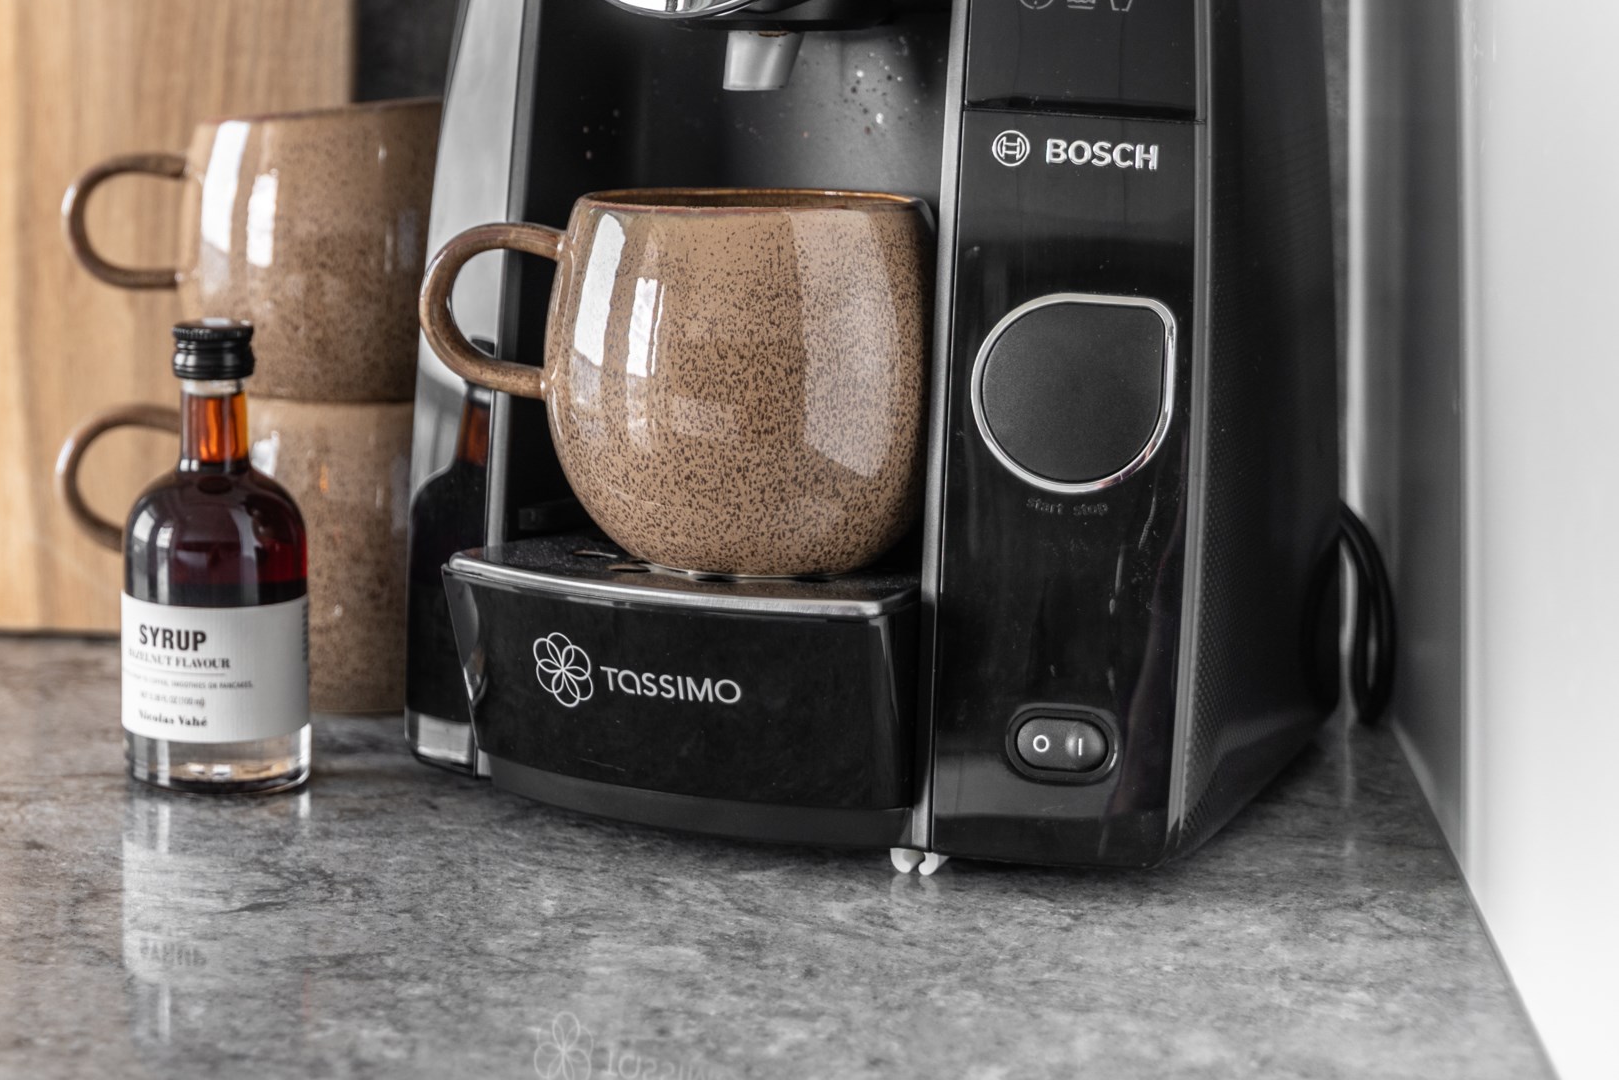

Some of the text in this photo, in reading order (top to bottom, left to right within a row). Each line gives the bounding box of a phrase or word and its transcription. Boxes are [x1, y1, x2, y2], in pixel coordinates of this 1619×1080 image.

[1045, 138, 1159, 170] BOSCH
[1026, 498, 1109, 517] start stop
[139, 623, 207, 652] SYRUP
[175, 656, 232, 669] FLAVOUR
